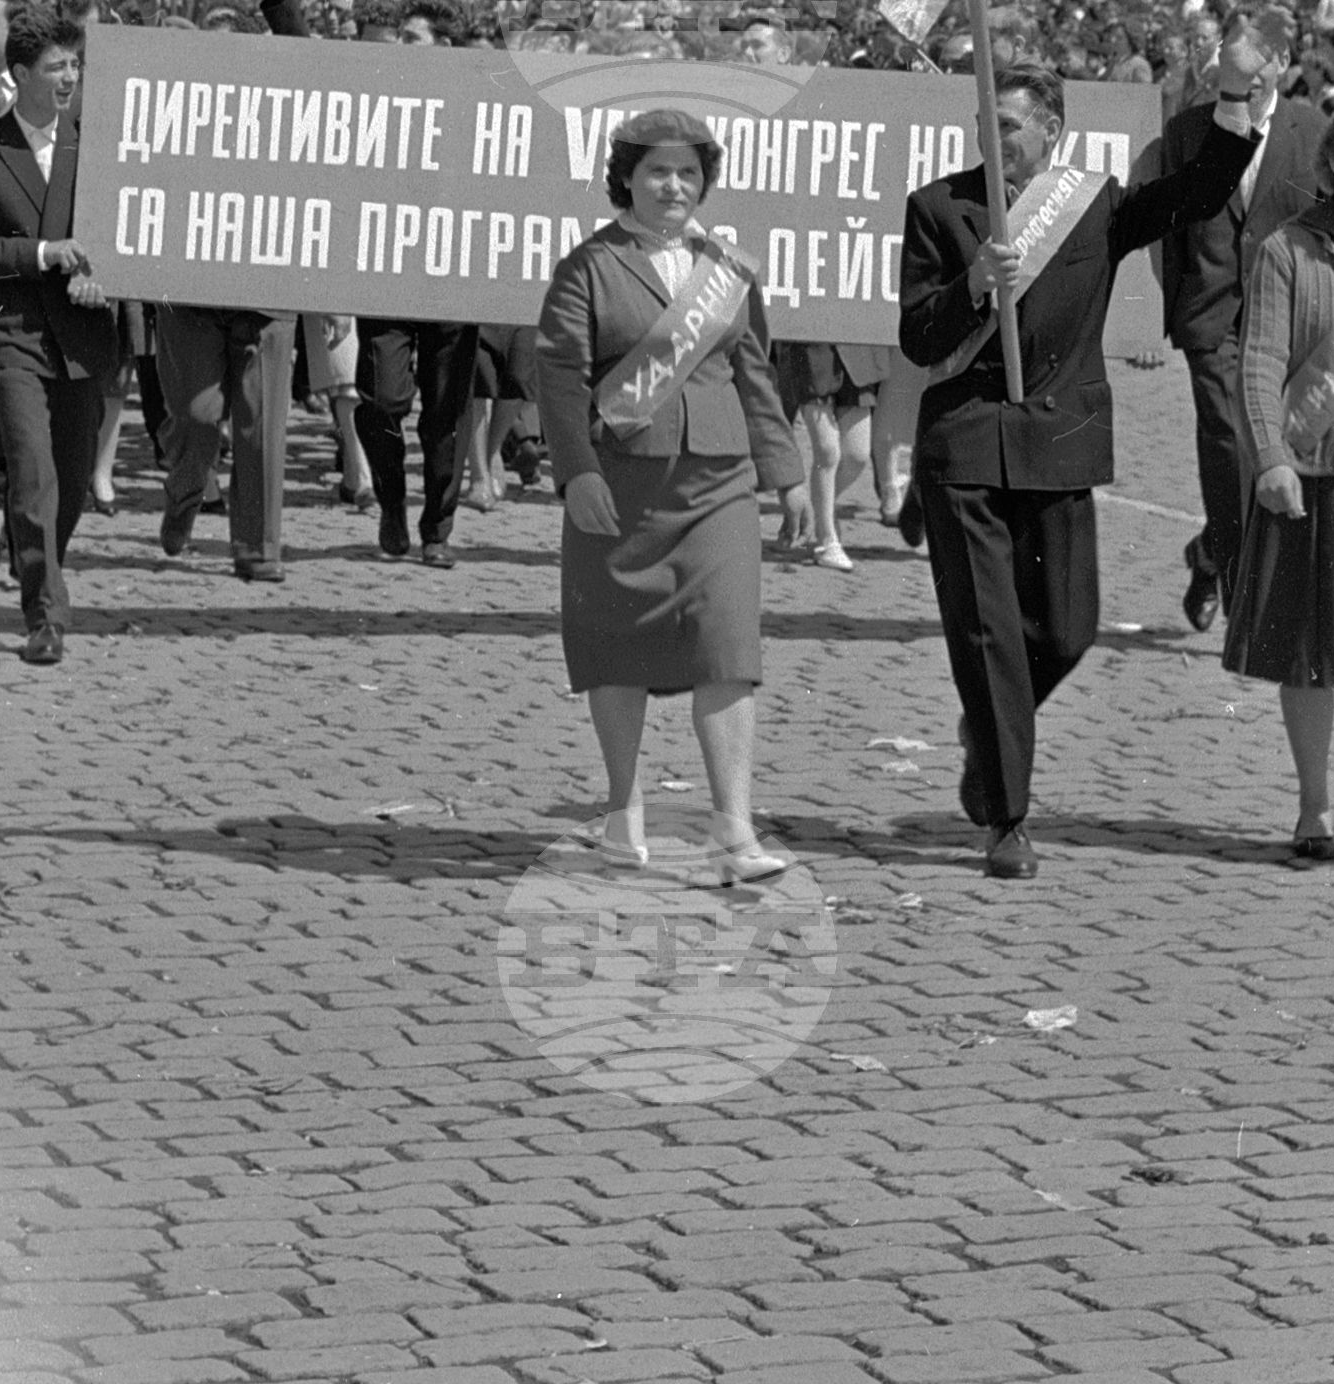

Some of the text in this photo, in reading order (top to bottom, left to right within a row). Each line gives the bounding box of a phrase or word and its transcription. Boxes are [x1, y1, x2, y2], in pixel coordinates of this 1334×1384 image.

[118, 78, 444, 171] ДИРЕКТИВИТЕ
[473, 102, 532, 177] НА
[706, 116, 885, 200] КОНГРЕС
[906, 125, 964, 196] НА
[116, 186, 165, 256] СА
[186, 191, 331, 268] НАША
[622, 264, 736, 403] УДАРНИ
